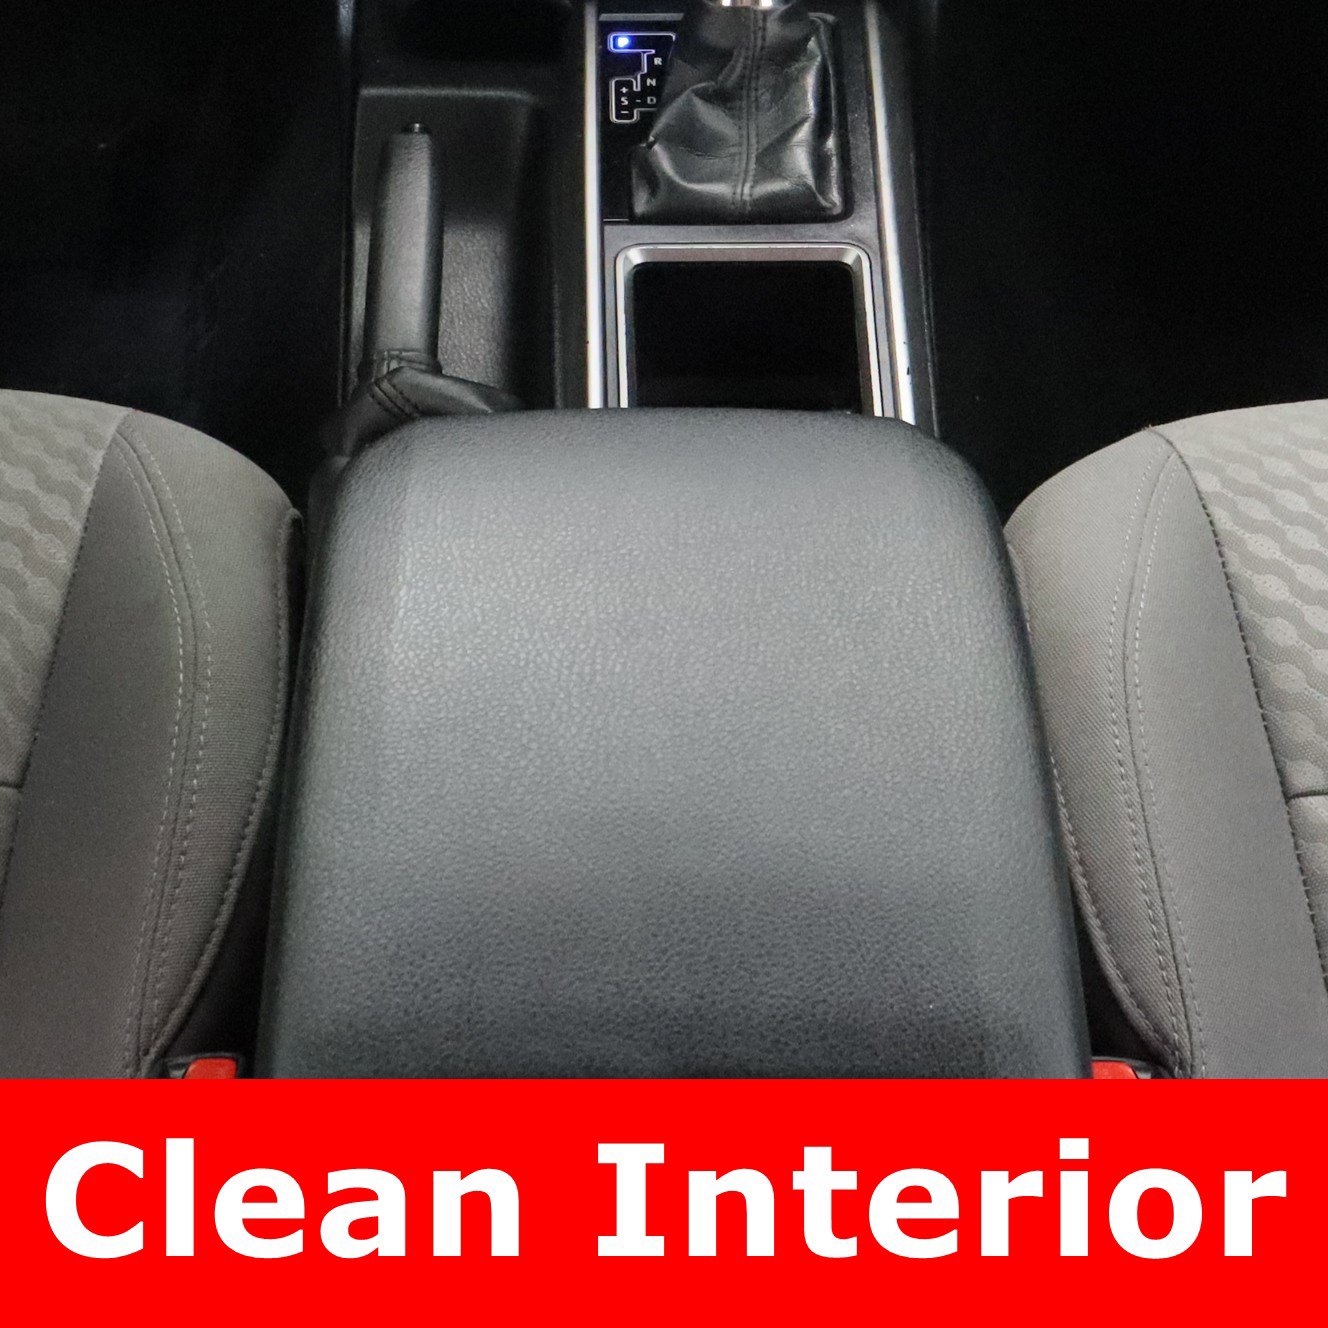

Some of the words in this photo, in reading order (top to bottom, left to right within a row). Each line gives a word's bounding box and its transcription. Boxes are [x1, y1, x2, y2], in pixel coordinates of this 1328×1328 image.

[654, 57, 663, 66] R
[646, 78, 657, 87] N
[620, 96, 629, 106] S
[647, 96, 657, 105] D
